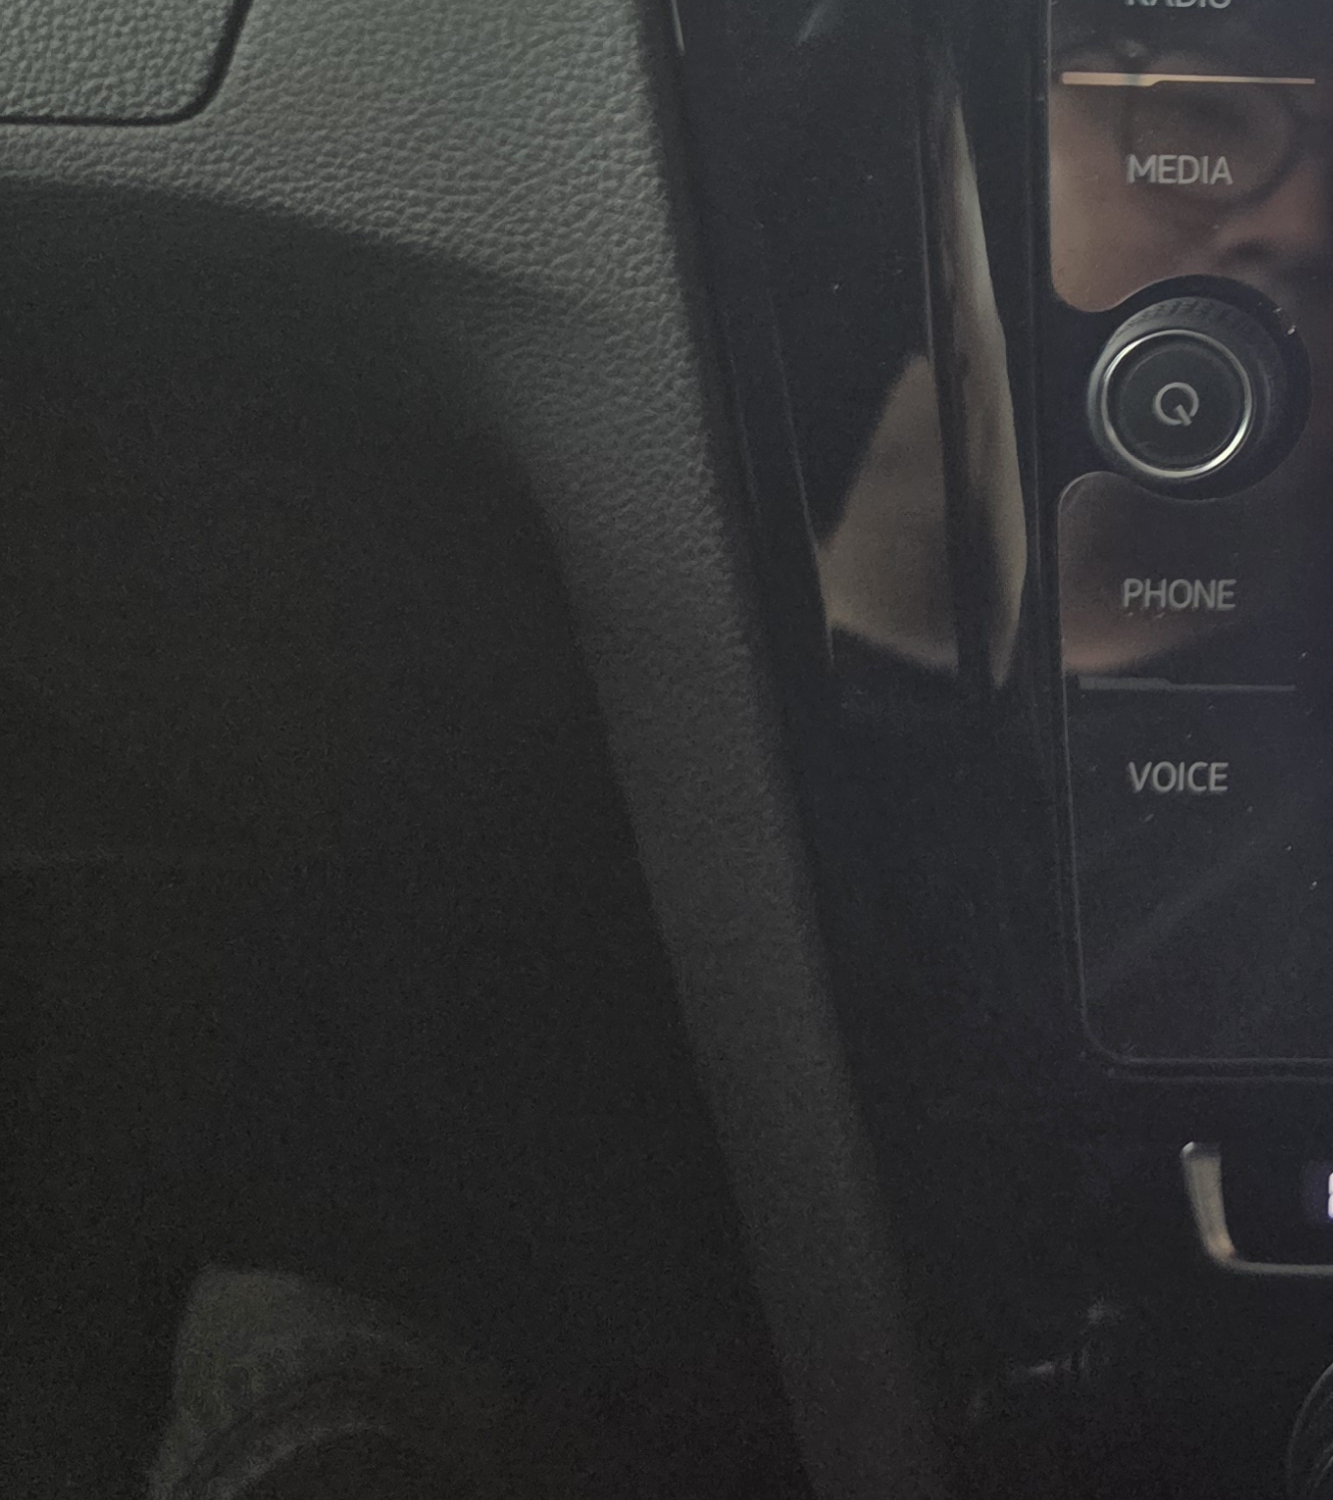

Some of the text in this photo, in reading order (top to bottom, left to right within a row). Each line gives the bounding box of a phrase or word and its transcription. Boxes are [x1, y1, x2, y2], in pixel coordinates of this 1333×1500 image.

[1127, 154, 1233, 187] MEDIA
[1122, 577, 1237, 611] PHONE
[1128, 760, 1229, 794] VOICE
